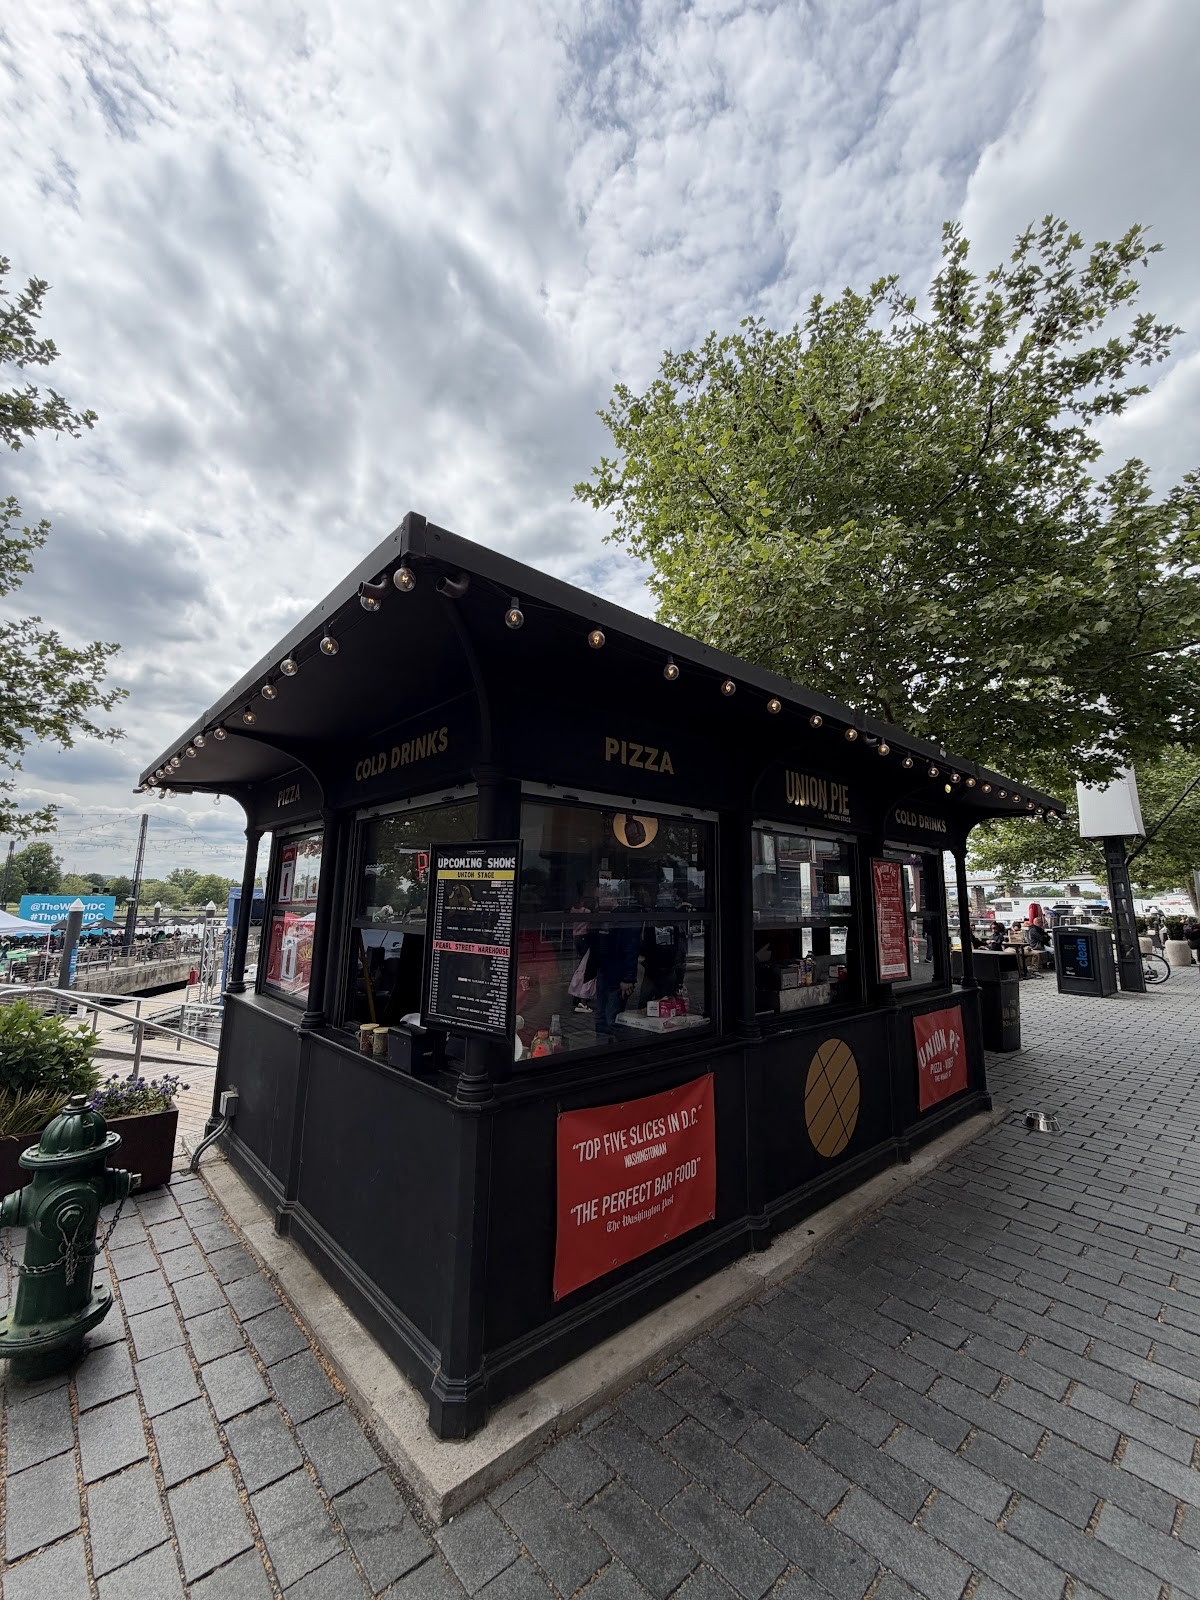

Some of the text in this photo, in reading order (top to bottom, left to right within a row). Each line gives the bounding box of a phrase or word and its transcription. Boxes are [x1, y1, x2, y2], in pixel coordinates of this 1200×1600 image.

[355, 726, 448, 781] COLD DRINKS
[605, 736, 675, 775] PIZZA
[277, 783, 301, 808] PIZZA
[785, 769, 850, 816] UNION PIE
[895, 808, 947, 833] COLD DRINKS
[437, 857, 516, 869] UPCOMING SHOWS
[477, 871, 495, 879] STAGE
[30, 902, 106, 912] @TheWrfDC
[30, 913, 104, 921] #TheWrfDC
[435, 941, 509, 956] PEARL STREET WAREHOUSE
[1076, 938, 1088, 967] clean
[918, 1028, 947, 1070] UNION
[930, 1061, 943, 1075] PIZZA
[603, 1129, 628, 1156] FIVE
[629, 1117, 666, 1146] SLICES
[667, 1113, 680, 1133] IN
[624, 1142, 668, 1169] WASHINGTONIAN
[602, 1180, 653, 1217] PERFECT
[654, 1171, 673, 1197] BAR
[606, 1194, 674, 1233] The Washington Post
